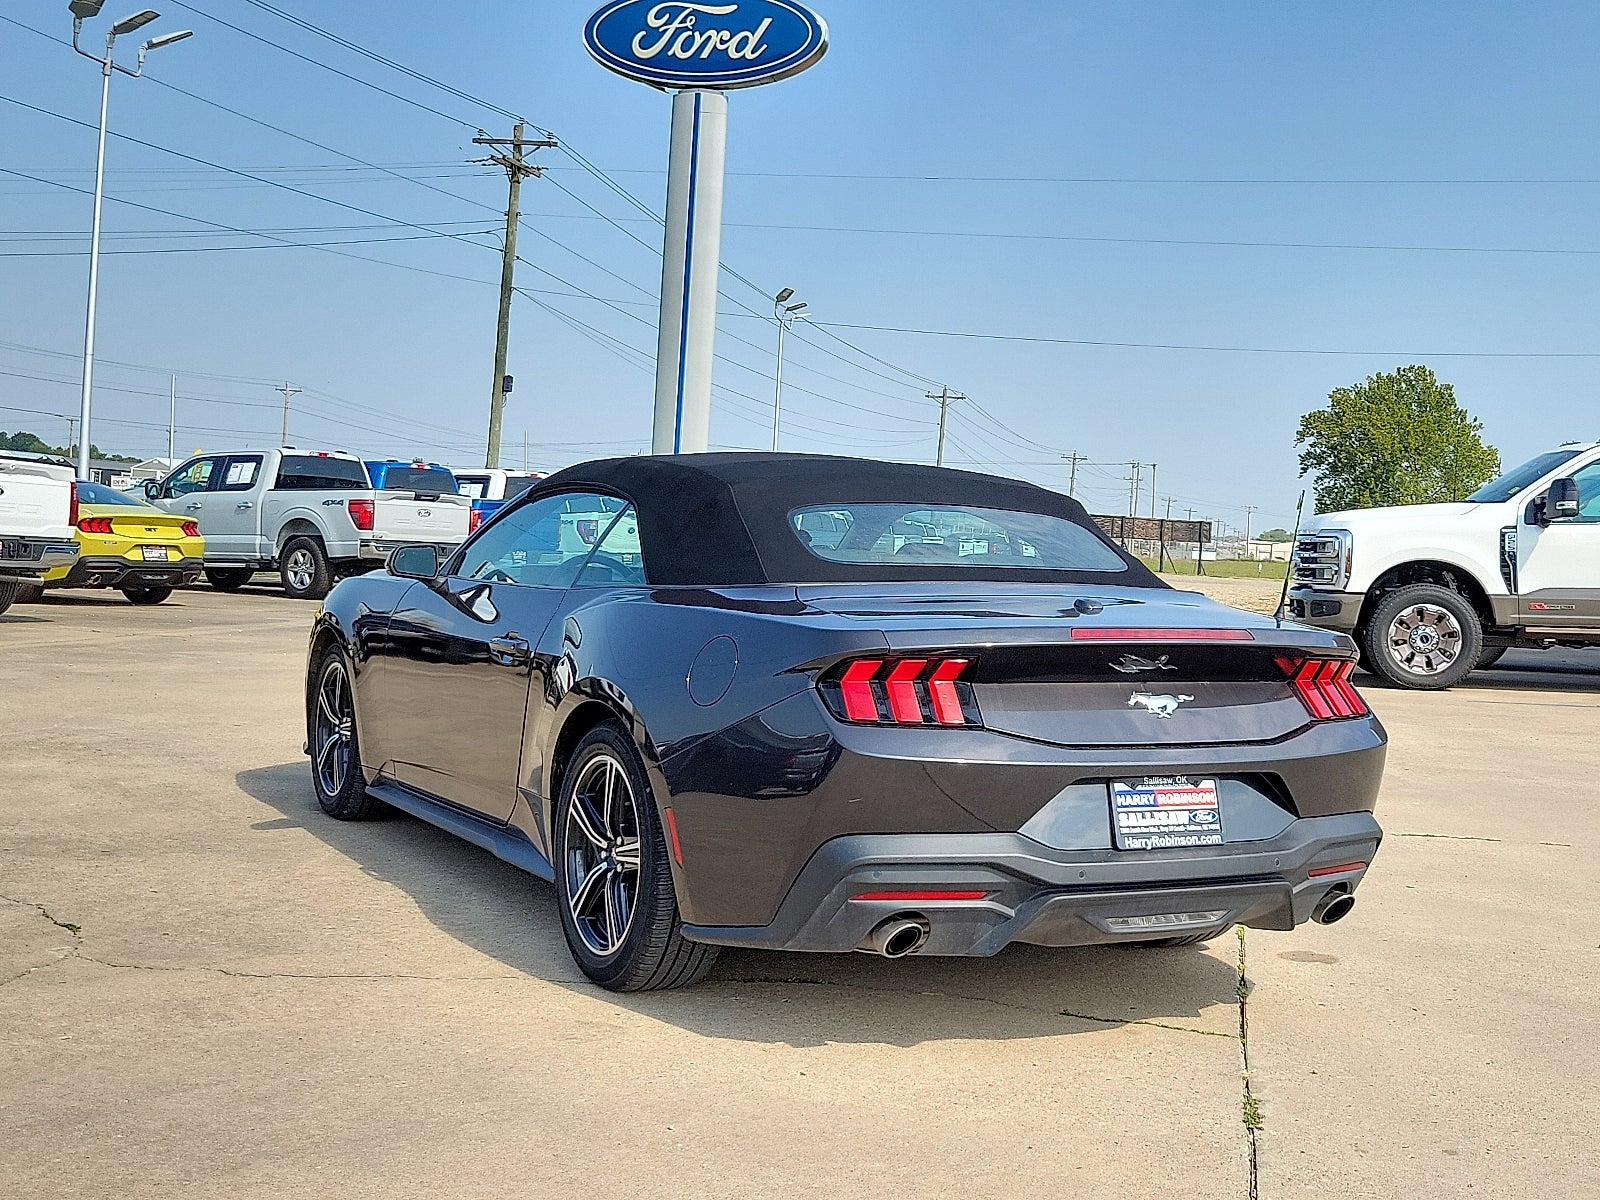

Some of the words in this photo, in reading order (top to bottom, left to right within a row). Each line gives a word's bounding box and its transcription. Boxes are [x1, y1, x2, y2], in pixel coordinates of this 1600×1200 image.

[631, 1, 773, 59] Ford
[1176, 775, 1188, 784] OK
[1116, 793, 1155, 806] HARRY
[1158, 791, 1216, 806] ROBINSON
[1118, 810, 1190, 827] SALLISAW
[1124, 834, 1222, 850] HarryRobinson.com
